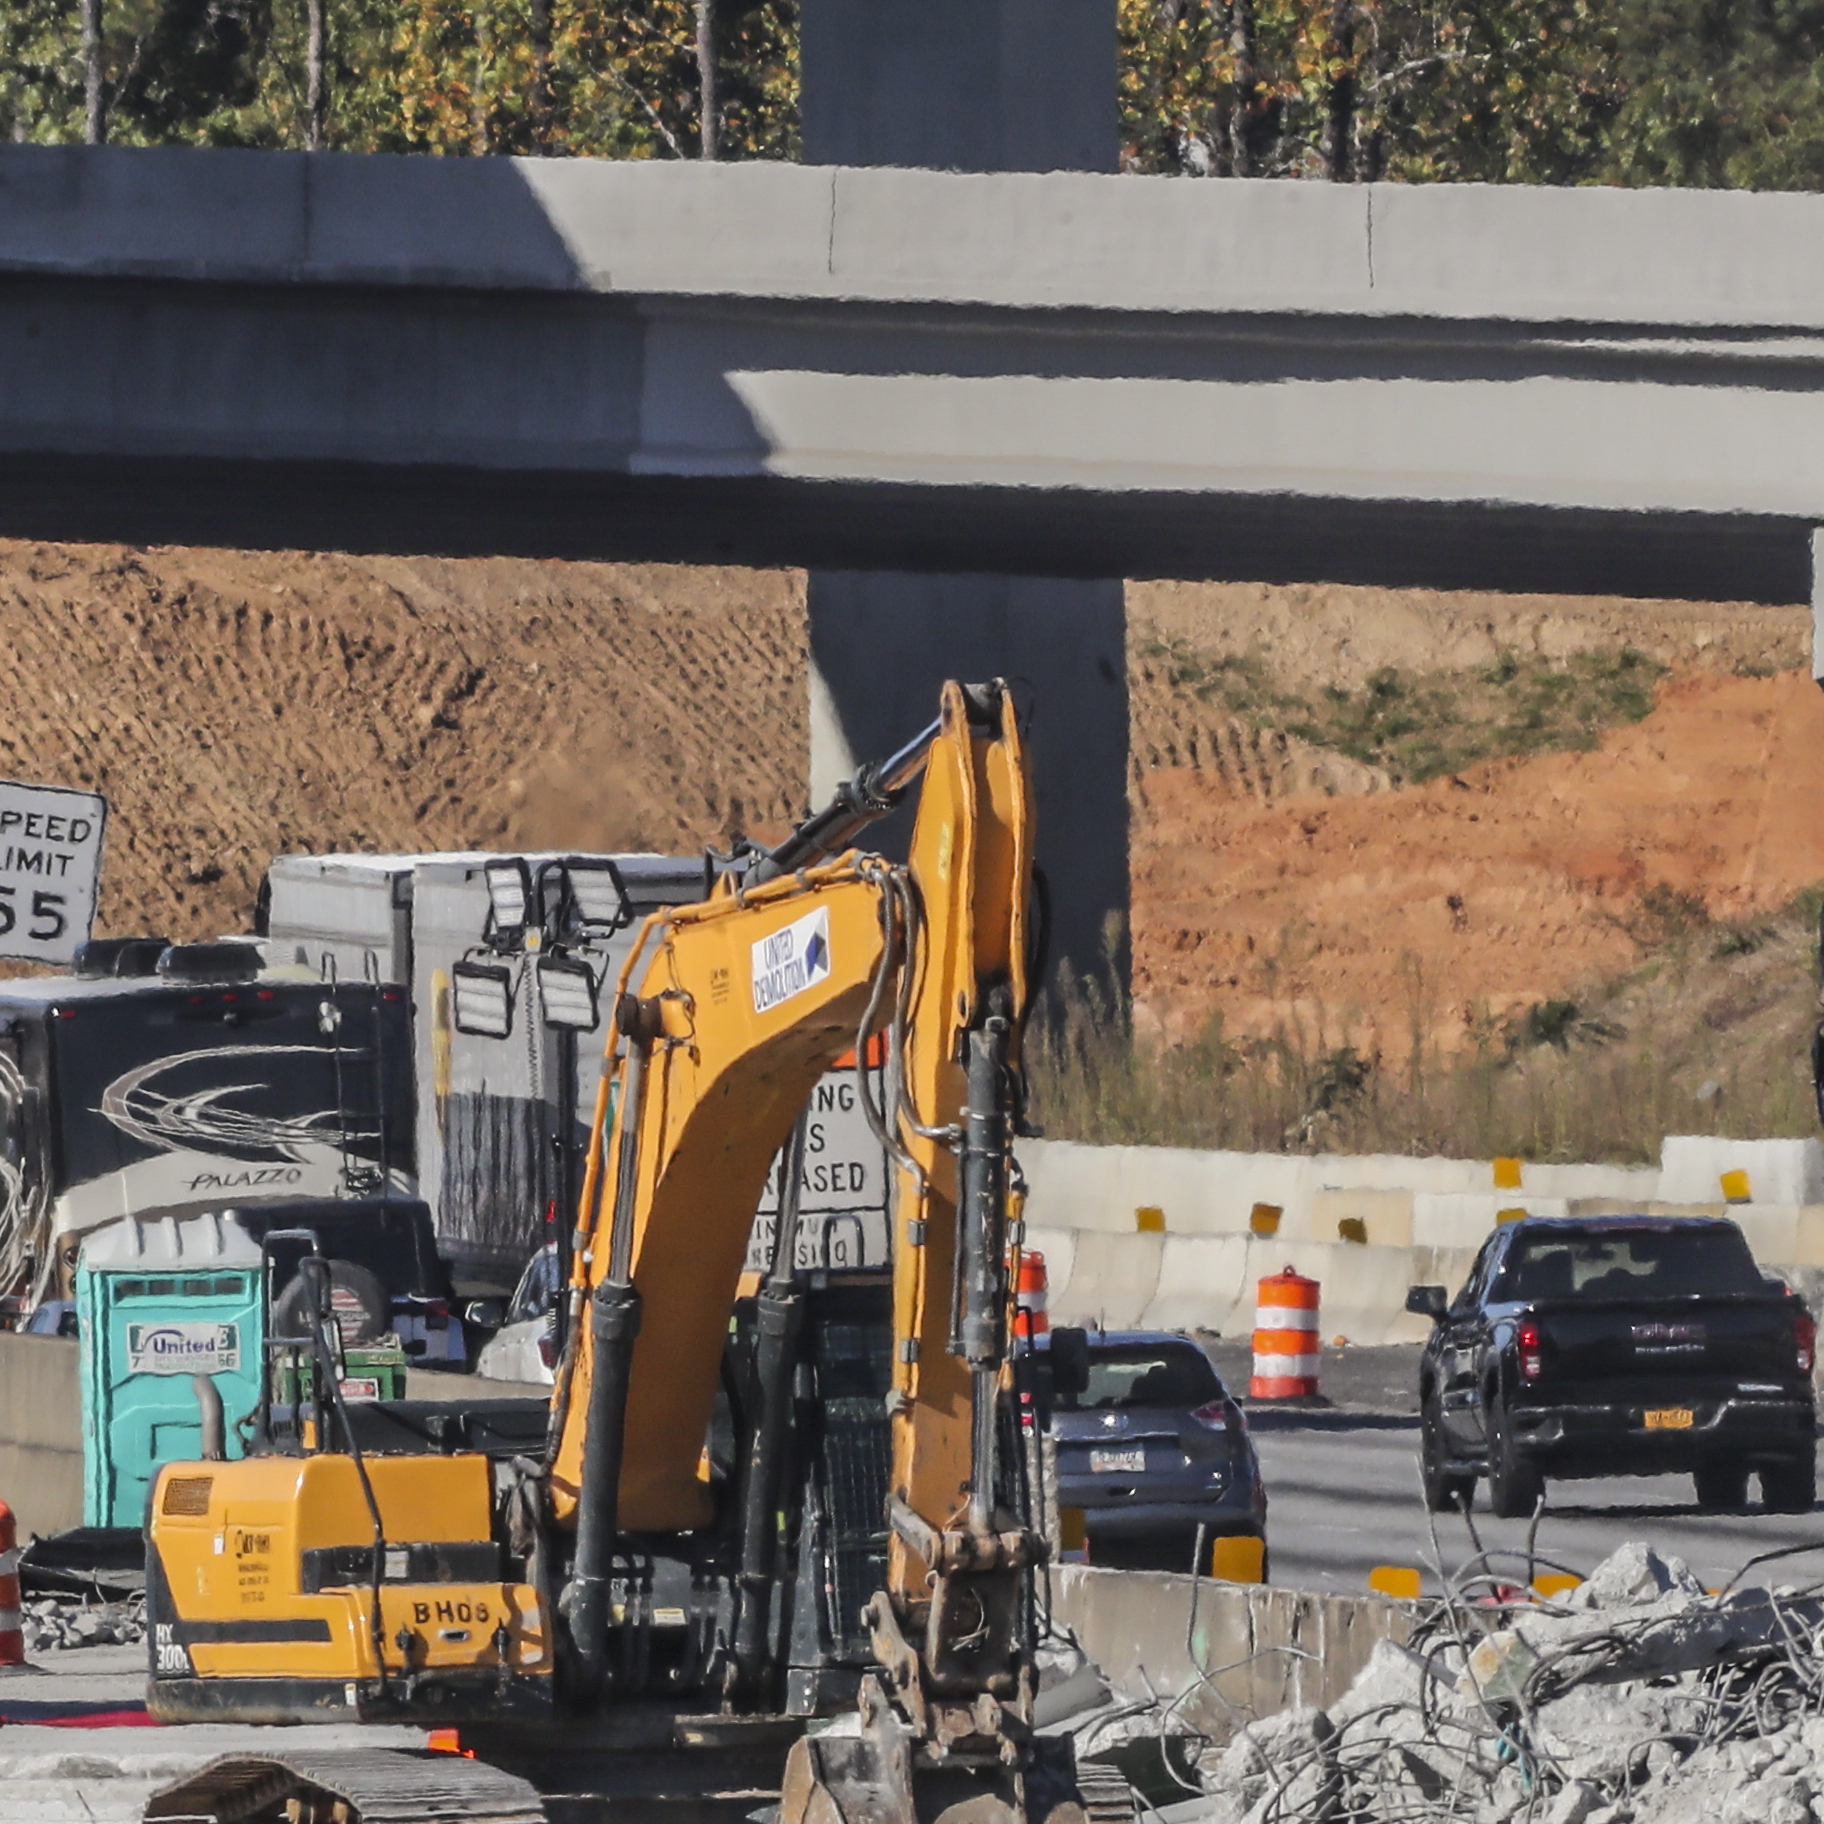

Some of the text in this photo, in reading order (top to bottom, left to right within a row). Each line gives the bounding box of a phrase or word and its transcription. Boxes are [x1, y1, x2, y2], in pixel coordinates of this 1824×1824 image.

[763, 928, 794, 971] UNITED
[754, 956, 807, 1010] DEMOLITION
[188, 1167, 302, 1191] PALAZZO
[153, 1338, 216, 1354] United
[414, 1603, 489, 1624] BH08
[156, 1623, 174, 1643] HX
